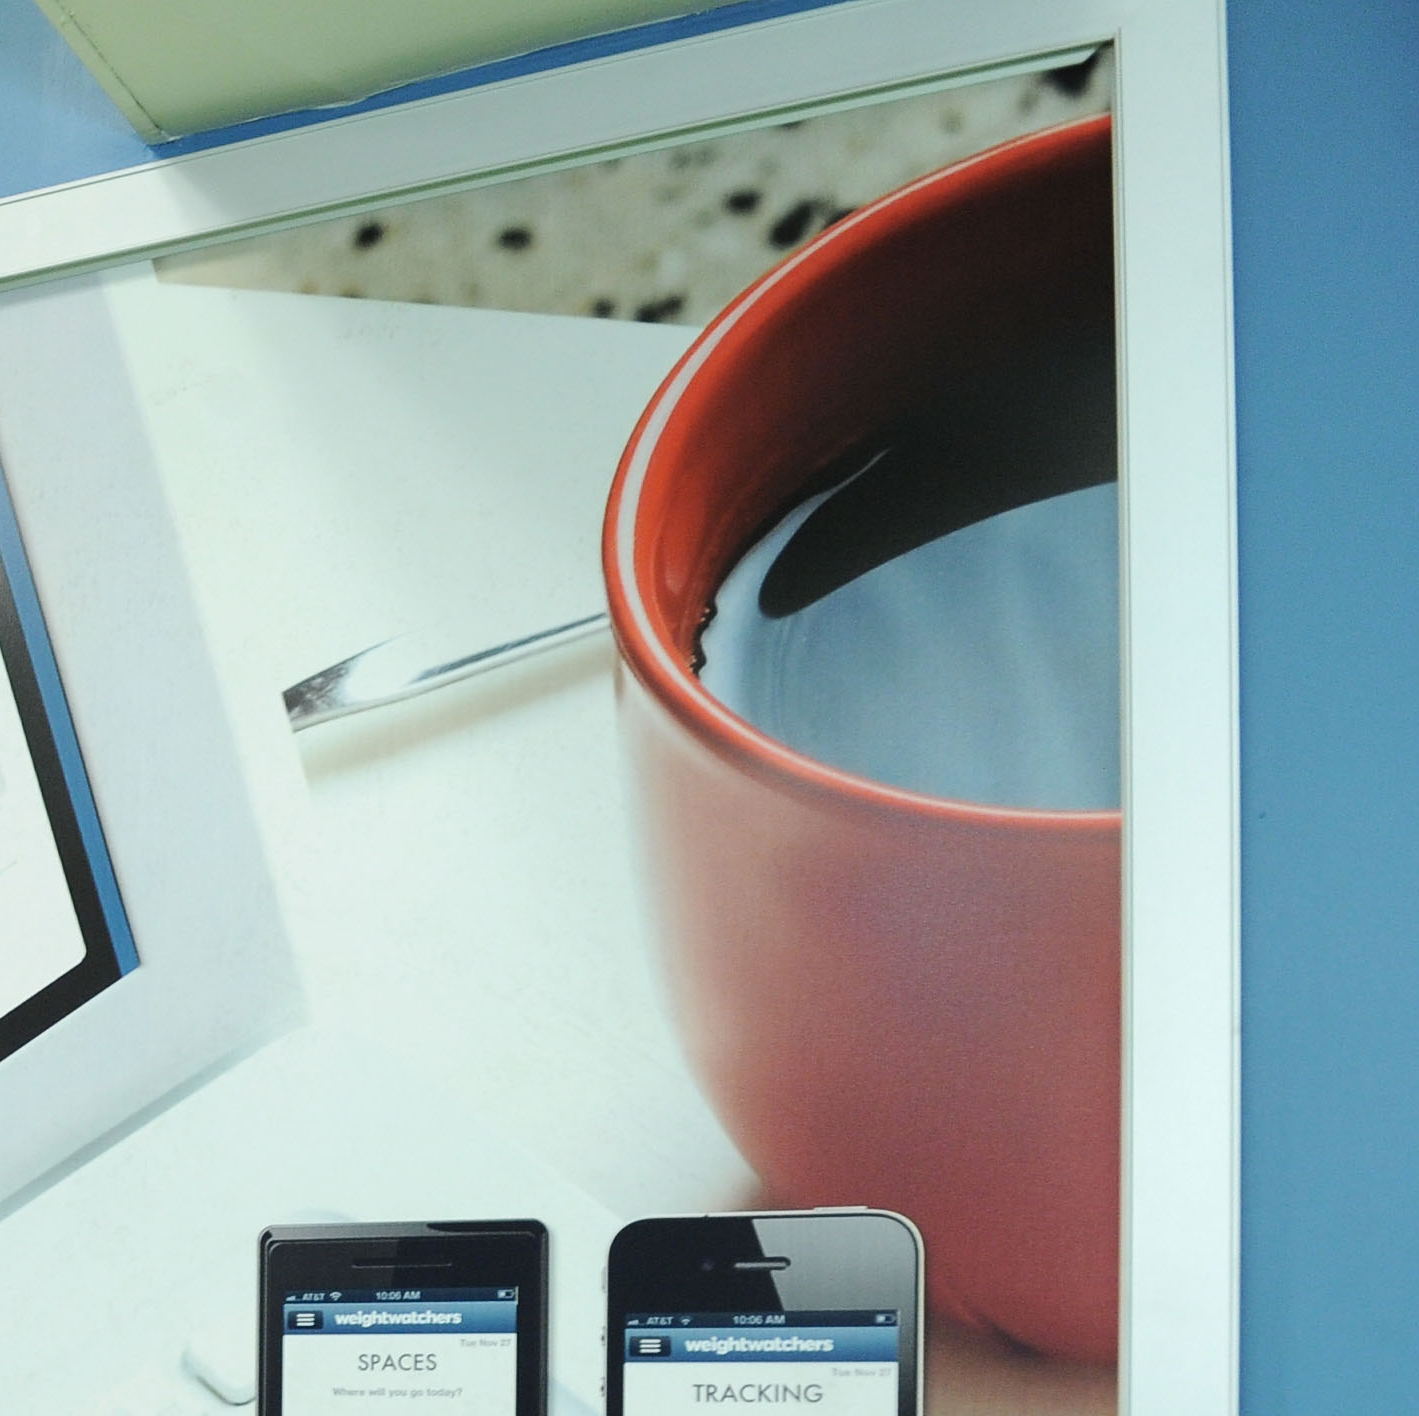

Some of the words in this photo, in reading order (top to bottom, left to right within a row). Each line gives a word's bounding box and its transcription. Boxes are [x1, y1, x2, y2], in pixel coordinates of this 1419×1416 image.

[334, 1310, 462, 1327] weightwatchers
[684, 1336, 834, 1355] weightwatchers
[357, 1354, 438, 1371] SPACES
[332, 1387, 366, 1397] Where
[692, 1384, 823, 1403] TRACKING
